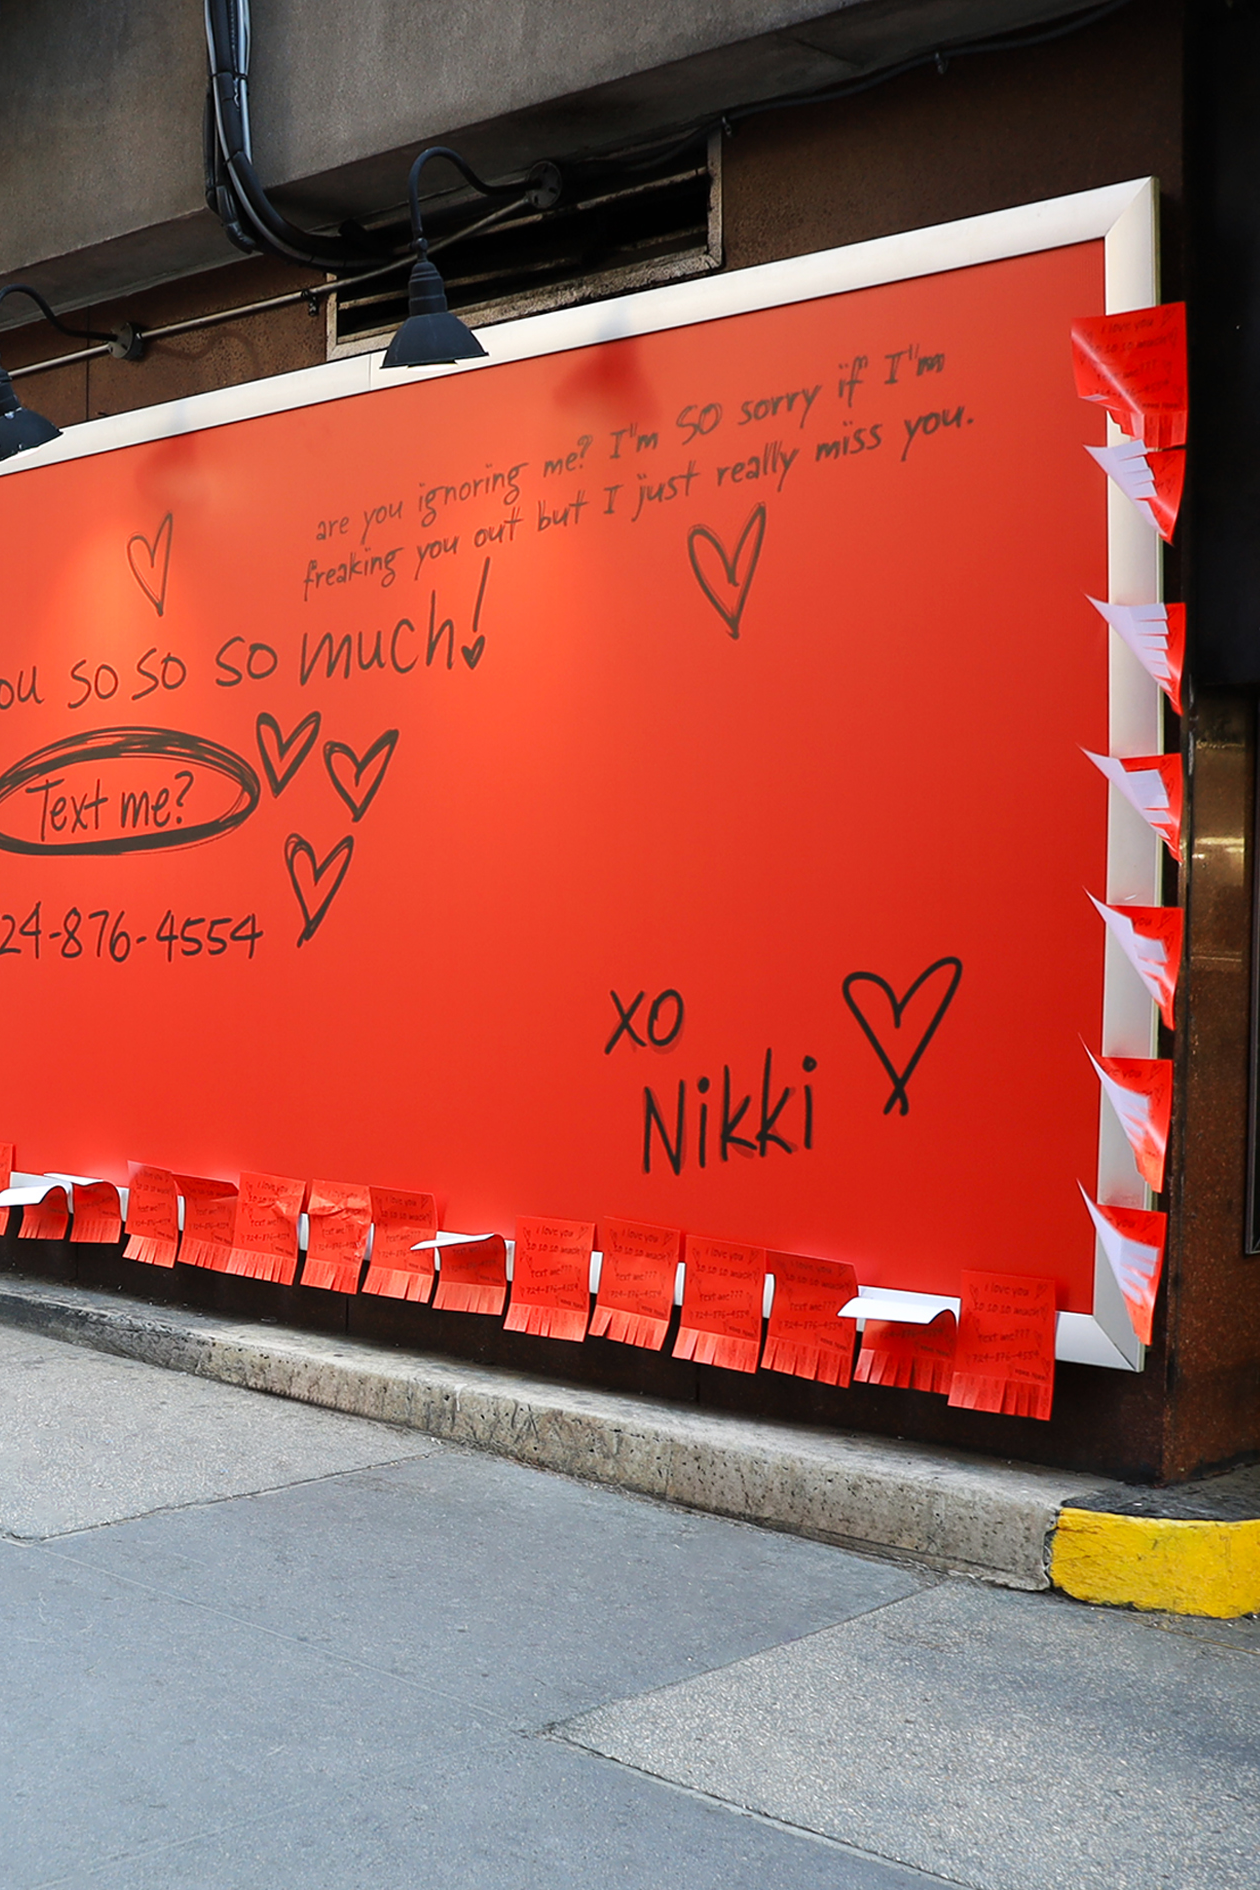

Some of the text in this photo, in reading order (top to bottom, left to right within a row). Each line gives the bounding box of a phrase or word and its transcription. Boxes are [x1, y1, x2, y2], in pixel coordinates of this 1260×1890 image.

[303, 405, 974, 603] freaking you out but I just really miss you.
[316, 515, 350, 542] are
[360, 500, 404, 546] you
[417, 461, 530, 528] ignoring
[542, 434, 593, 478] me?
[609, 421, 659, 459] I'm
[737, 383, 823, 430] sorry
[837, 353, 869, 408] if
[883, 342, 946, 386] I'm
[25, 770, 195, 842] Text me?
[642, 1046, 819, 1178] Nikki
